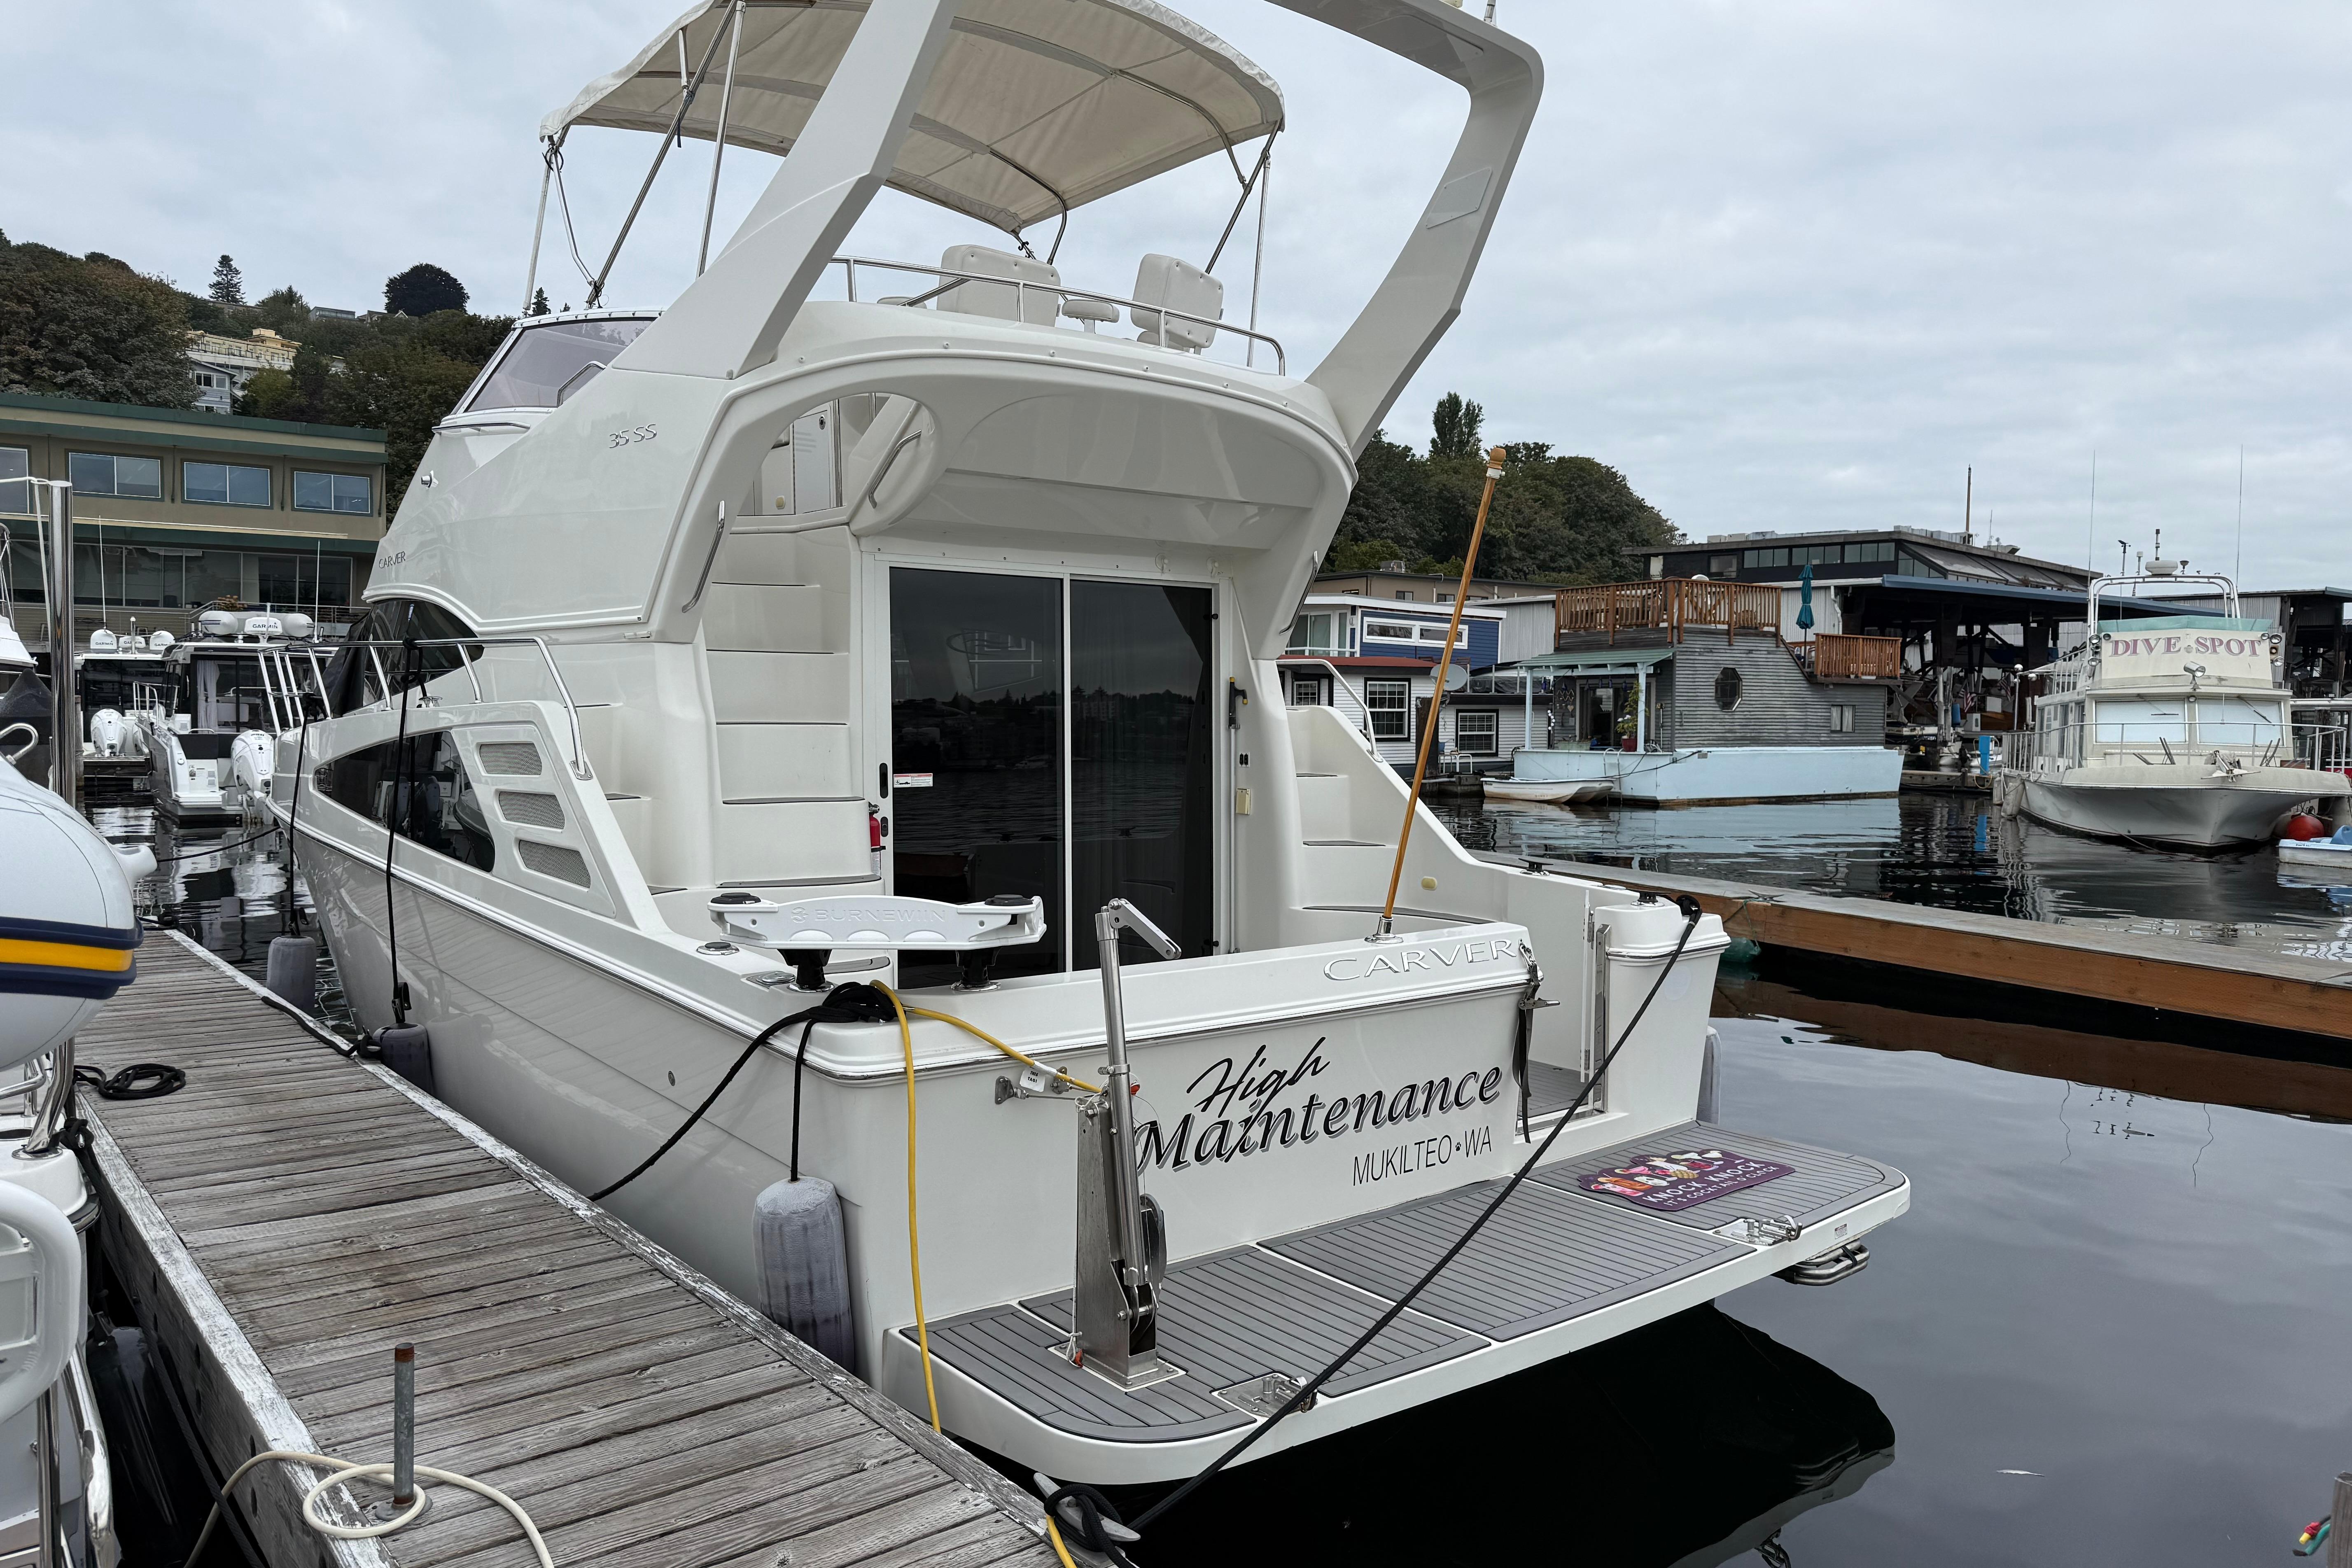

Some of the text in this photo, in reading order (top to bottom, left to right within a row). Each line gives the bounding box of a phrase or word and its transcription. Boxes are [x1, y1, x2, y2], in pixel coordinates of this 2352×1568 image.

[609, 423, 657, 448] 35 SS
[379, 551, 406, 569] CARVER
[2109, 637, 2261, 657] DIVE SPOT
[1323, 938, 1517, 981] CARVER
[1186, 1036, 1330, 1163] High
[1134, 1066, 1502, 1176] Maintenance
[1353, 1125, 1491, 1186] MUKILTEO WA
[1642, 1162, 1765, 1202] KNOCK KNOCK
[1663, 1166, 1779, 1206] IT'S COCKTAIL O'CLOCK
